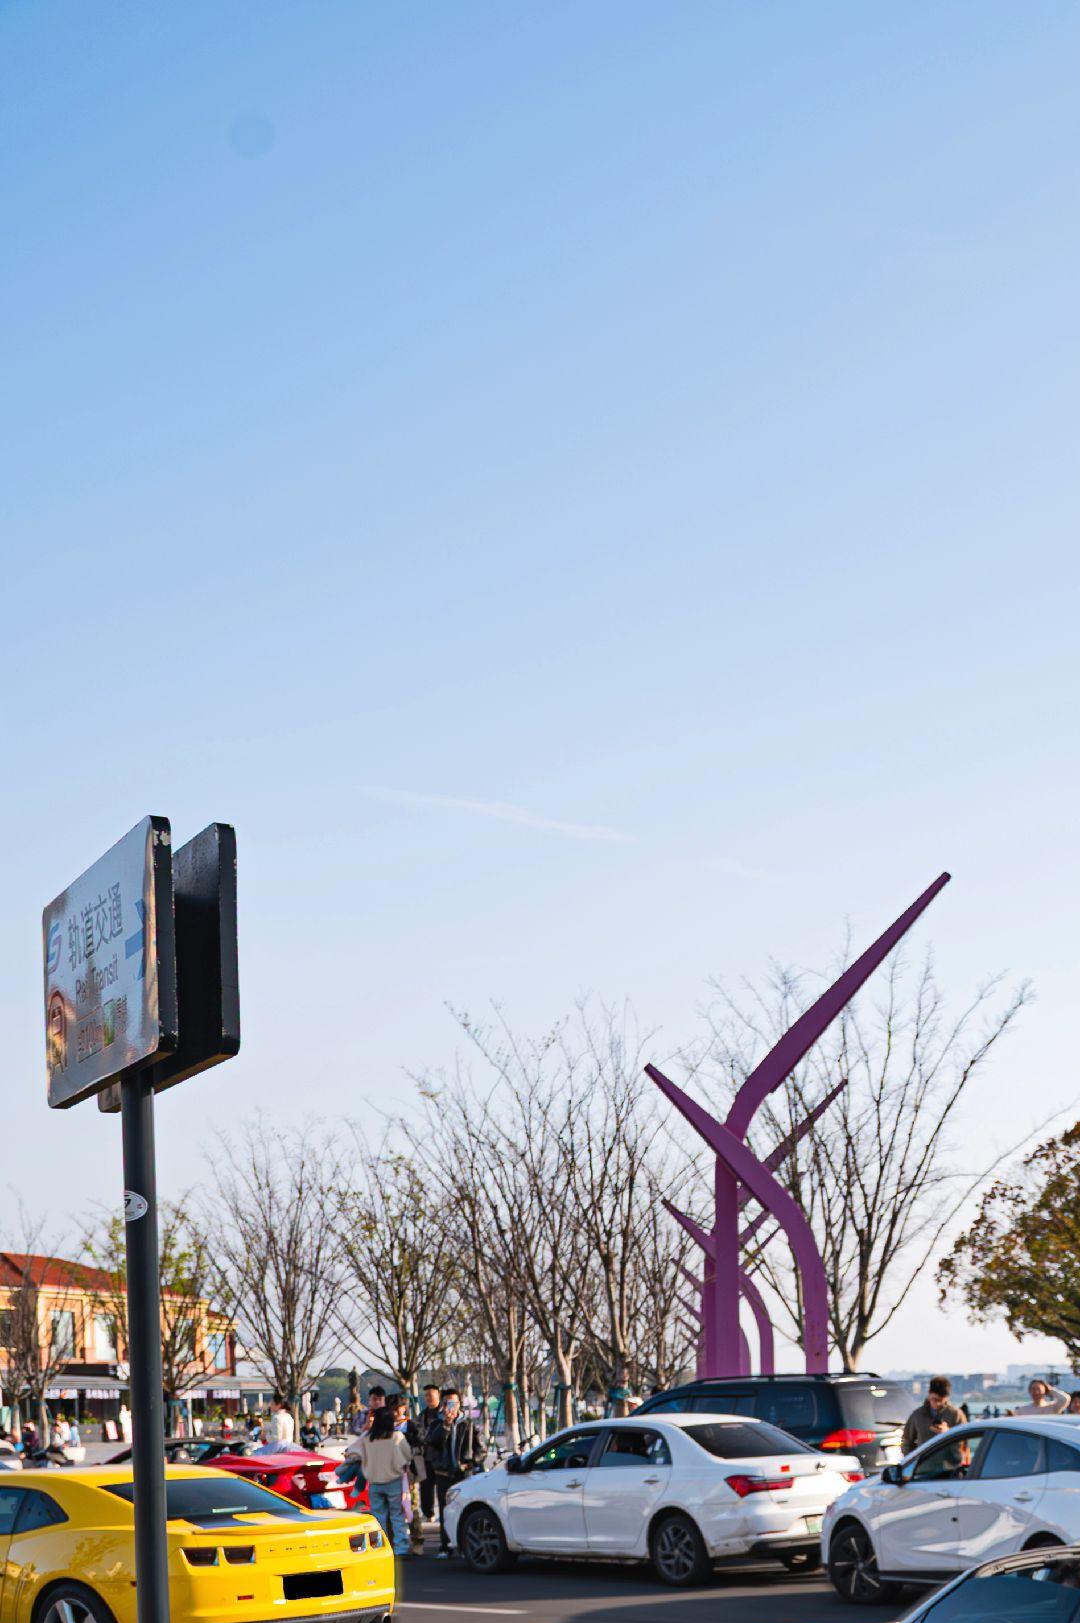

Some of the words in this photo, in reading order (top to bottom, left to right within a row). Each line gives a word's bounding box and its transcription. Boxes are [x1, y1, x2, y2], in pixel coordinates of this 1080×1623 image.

[67, 881, 124, 972] 轨道交通
[91, 953, 119, 995] Transit
